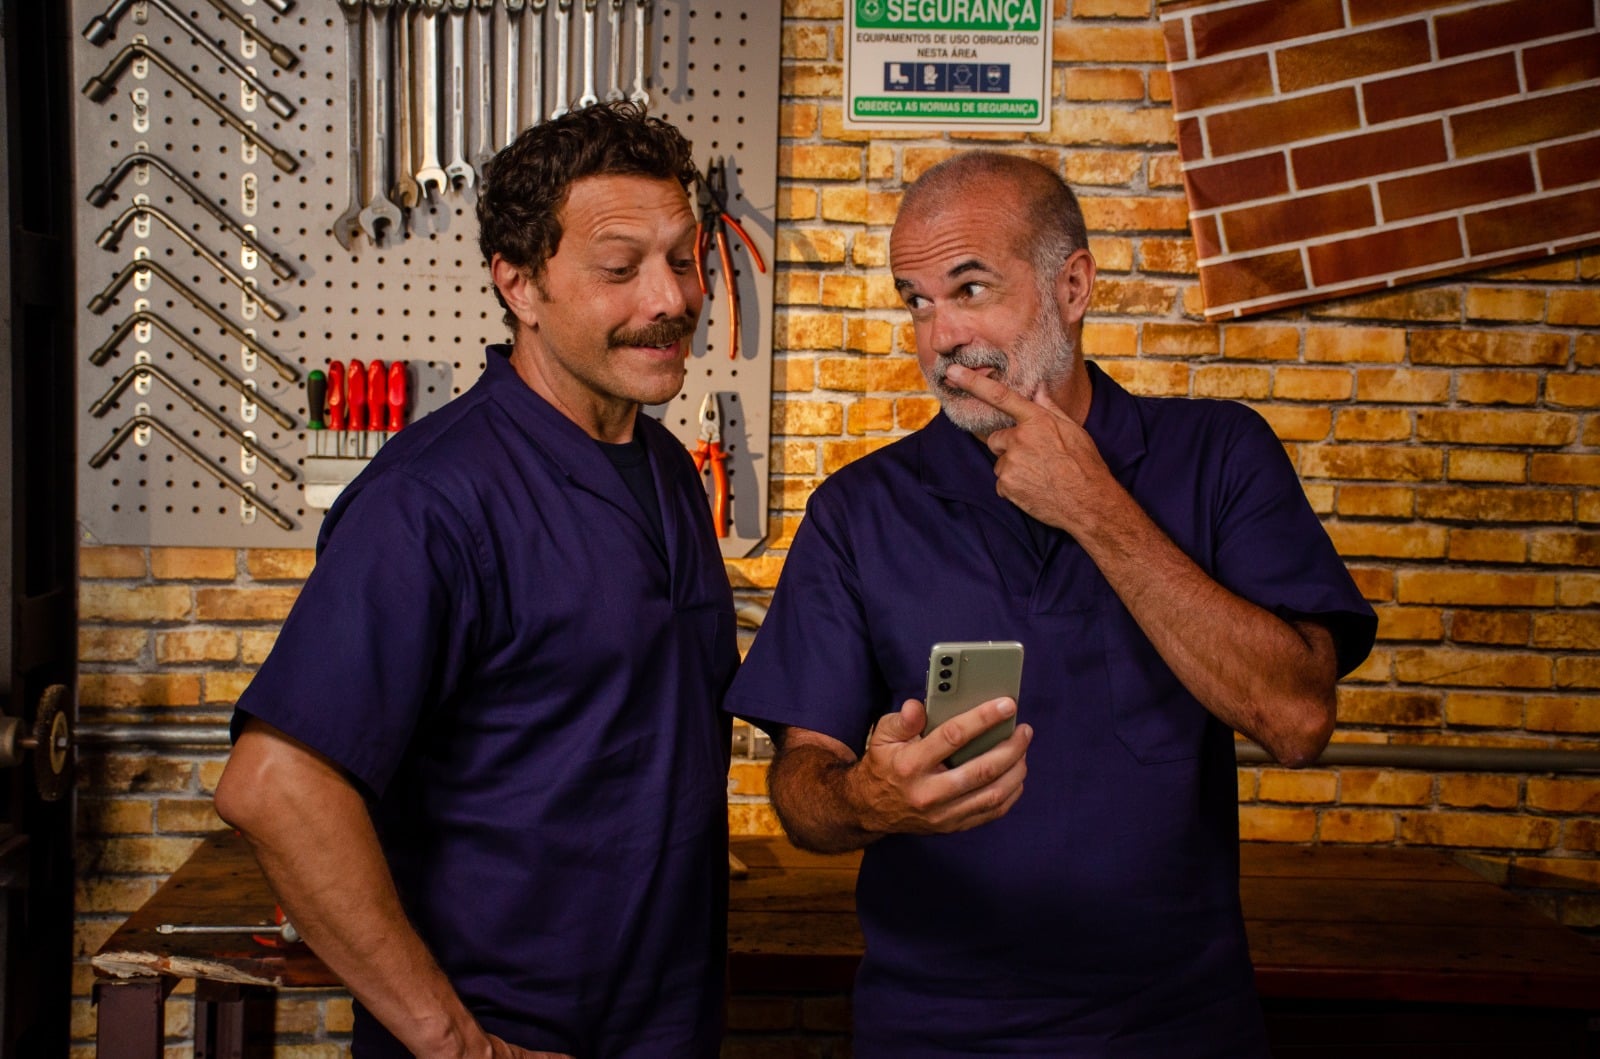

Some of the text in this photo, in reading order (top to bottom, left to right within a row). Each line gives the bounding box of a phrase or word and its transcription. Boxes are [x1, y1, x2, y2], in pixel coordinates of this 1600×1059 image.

[887, 0, 1036, 30] SEGURANÇA
[856, 33, 1039, 46] EQUIPAMENTOS DE USO OBRIGATÓRIO
[917, 46, 977, 58] NESTA ÁREA
[857, 101, 1036, 115] OBEDEÇA AS NORMAS DE SEGURANÇA
